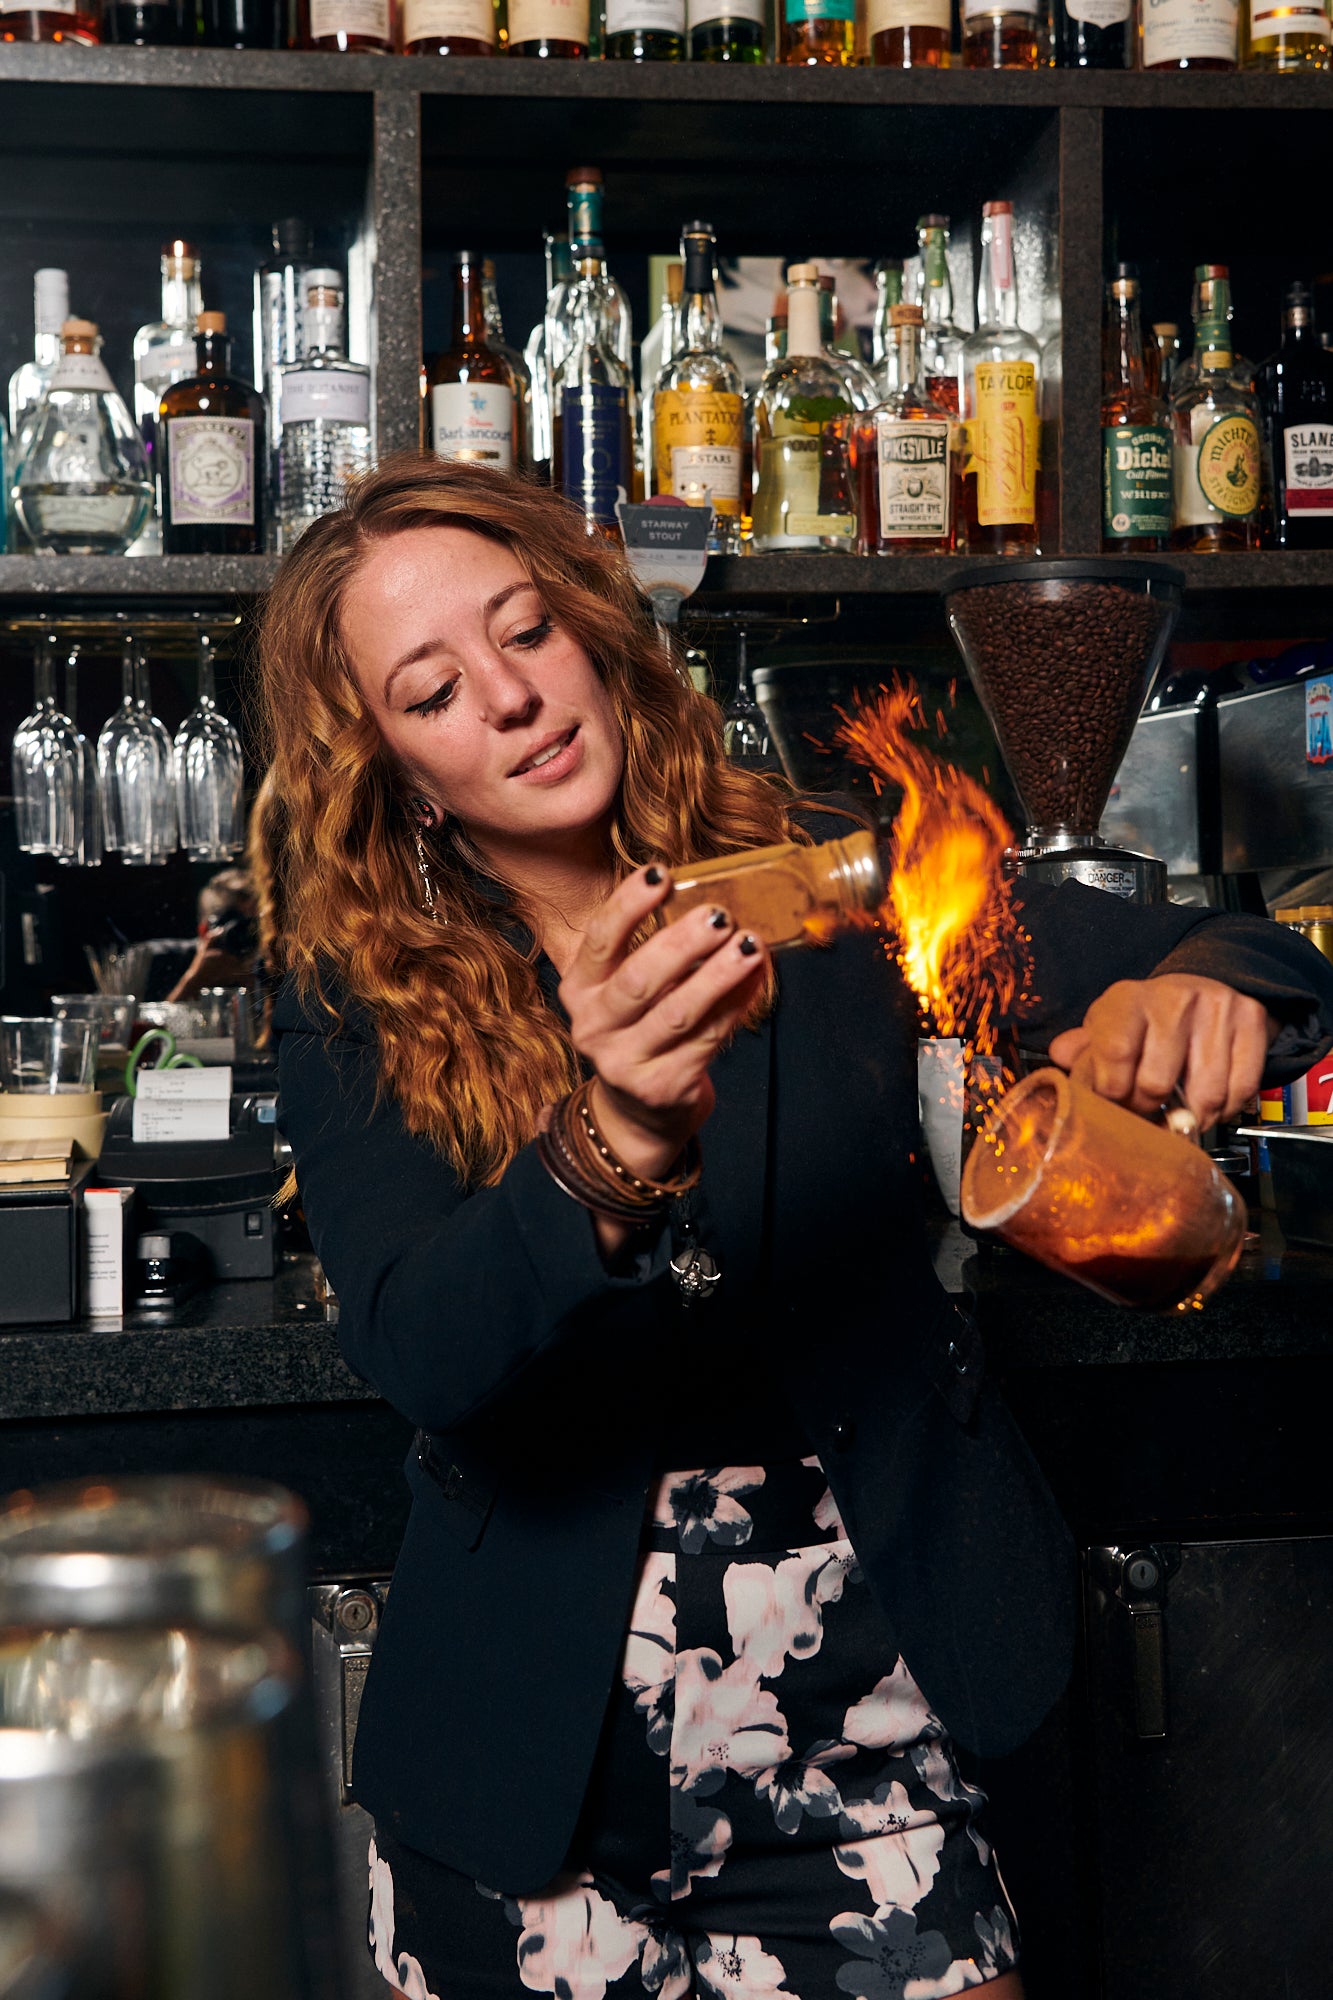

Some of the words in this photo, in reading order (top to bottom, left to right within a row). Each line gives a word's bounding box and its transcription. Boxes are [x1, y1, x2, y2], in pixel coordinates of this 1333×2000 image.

[979, 374, 1033, 390] TAYLOR
[883, 437, 944, 461] PIKESVILLE
[698, 454, 732, 465] STARS
[890, 503, 924, 514] STRAIGHT
[927, 503, 941, 514] RYE
[641, 520, 688, 529] STARWAY
[649, 532, 681, 540] STOUT
[1088, 872, 1125, 883] DANGER
